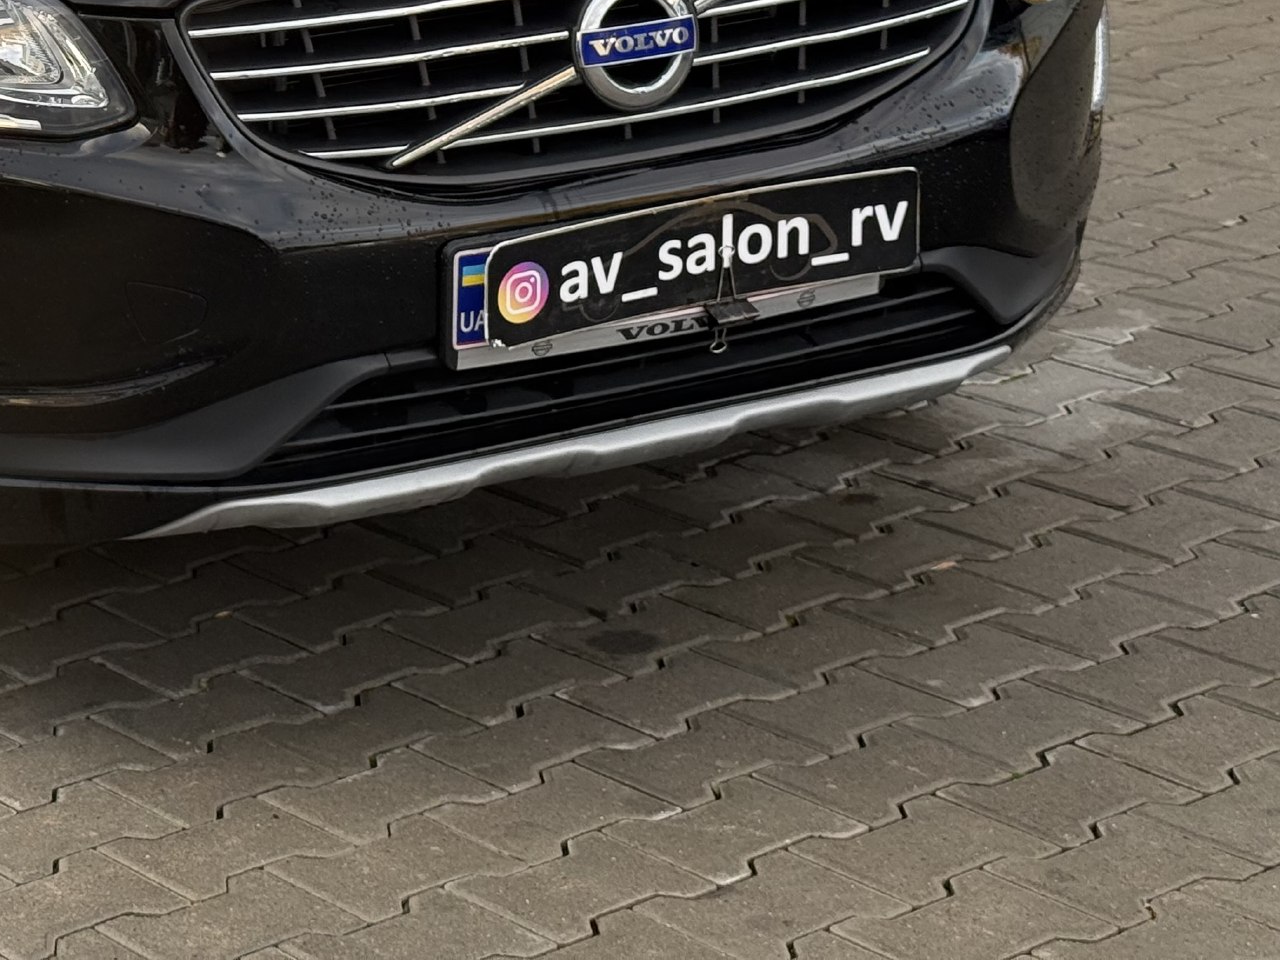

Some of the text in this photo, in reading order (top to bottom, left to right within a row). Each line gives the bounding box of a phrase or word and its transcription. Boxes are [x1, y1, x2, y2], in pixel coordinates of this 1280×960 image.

[588, 26, 689, 57] VOLVO
[559, 201, 908, 302] av_salon_rv
[460, 310, 485, 333] UA
[616, 315, 709, 341] VOLV
